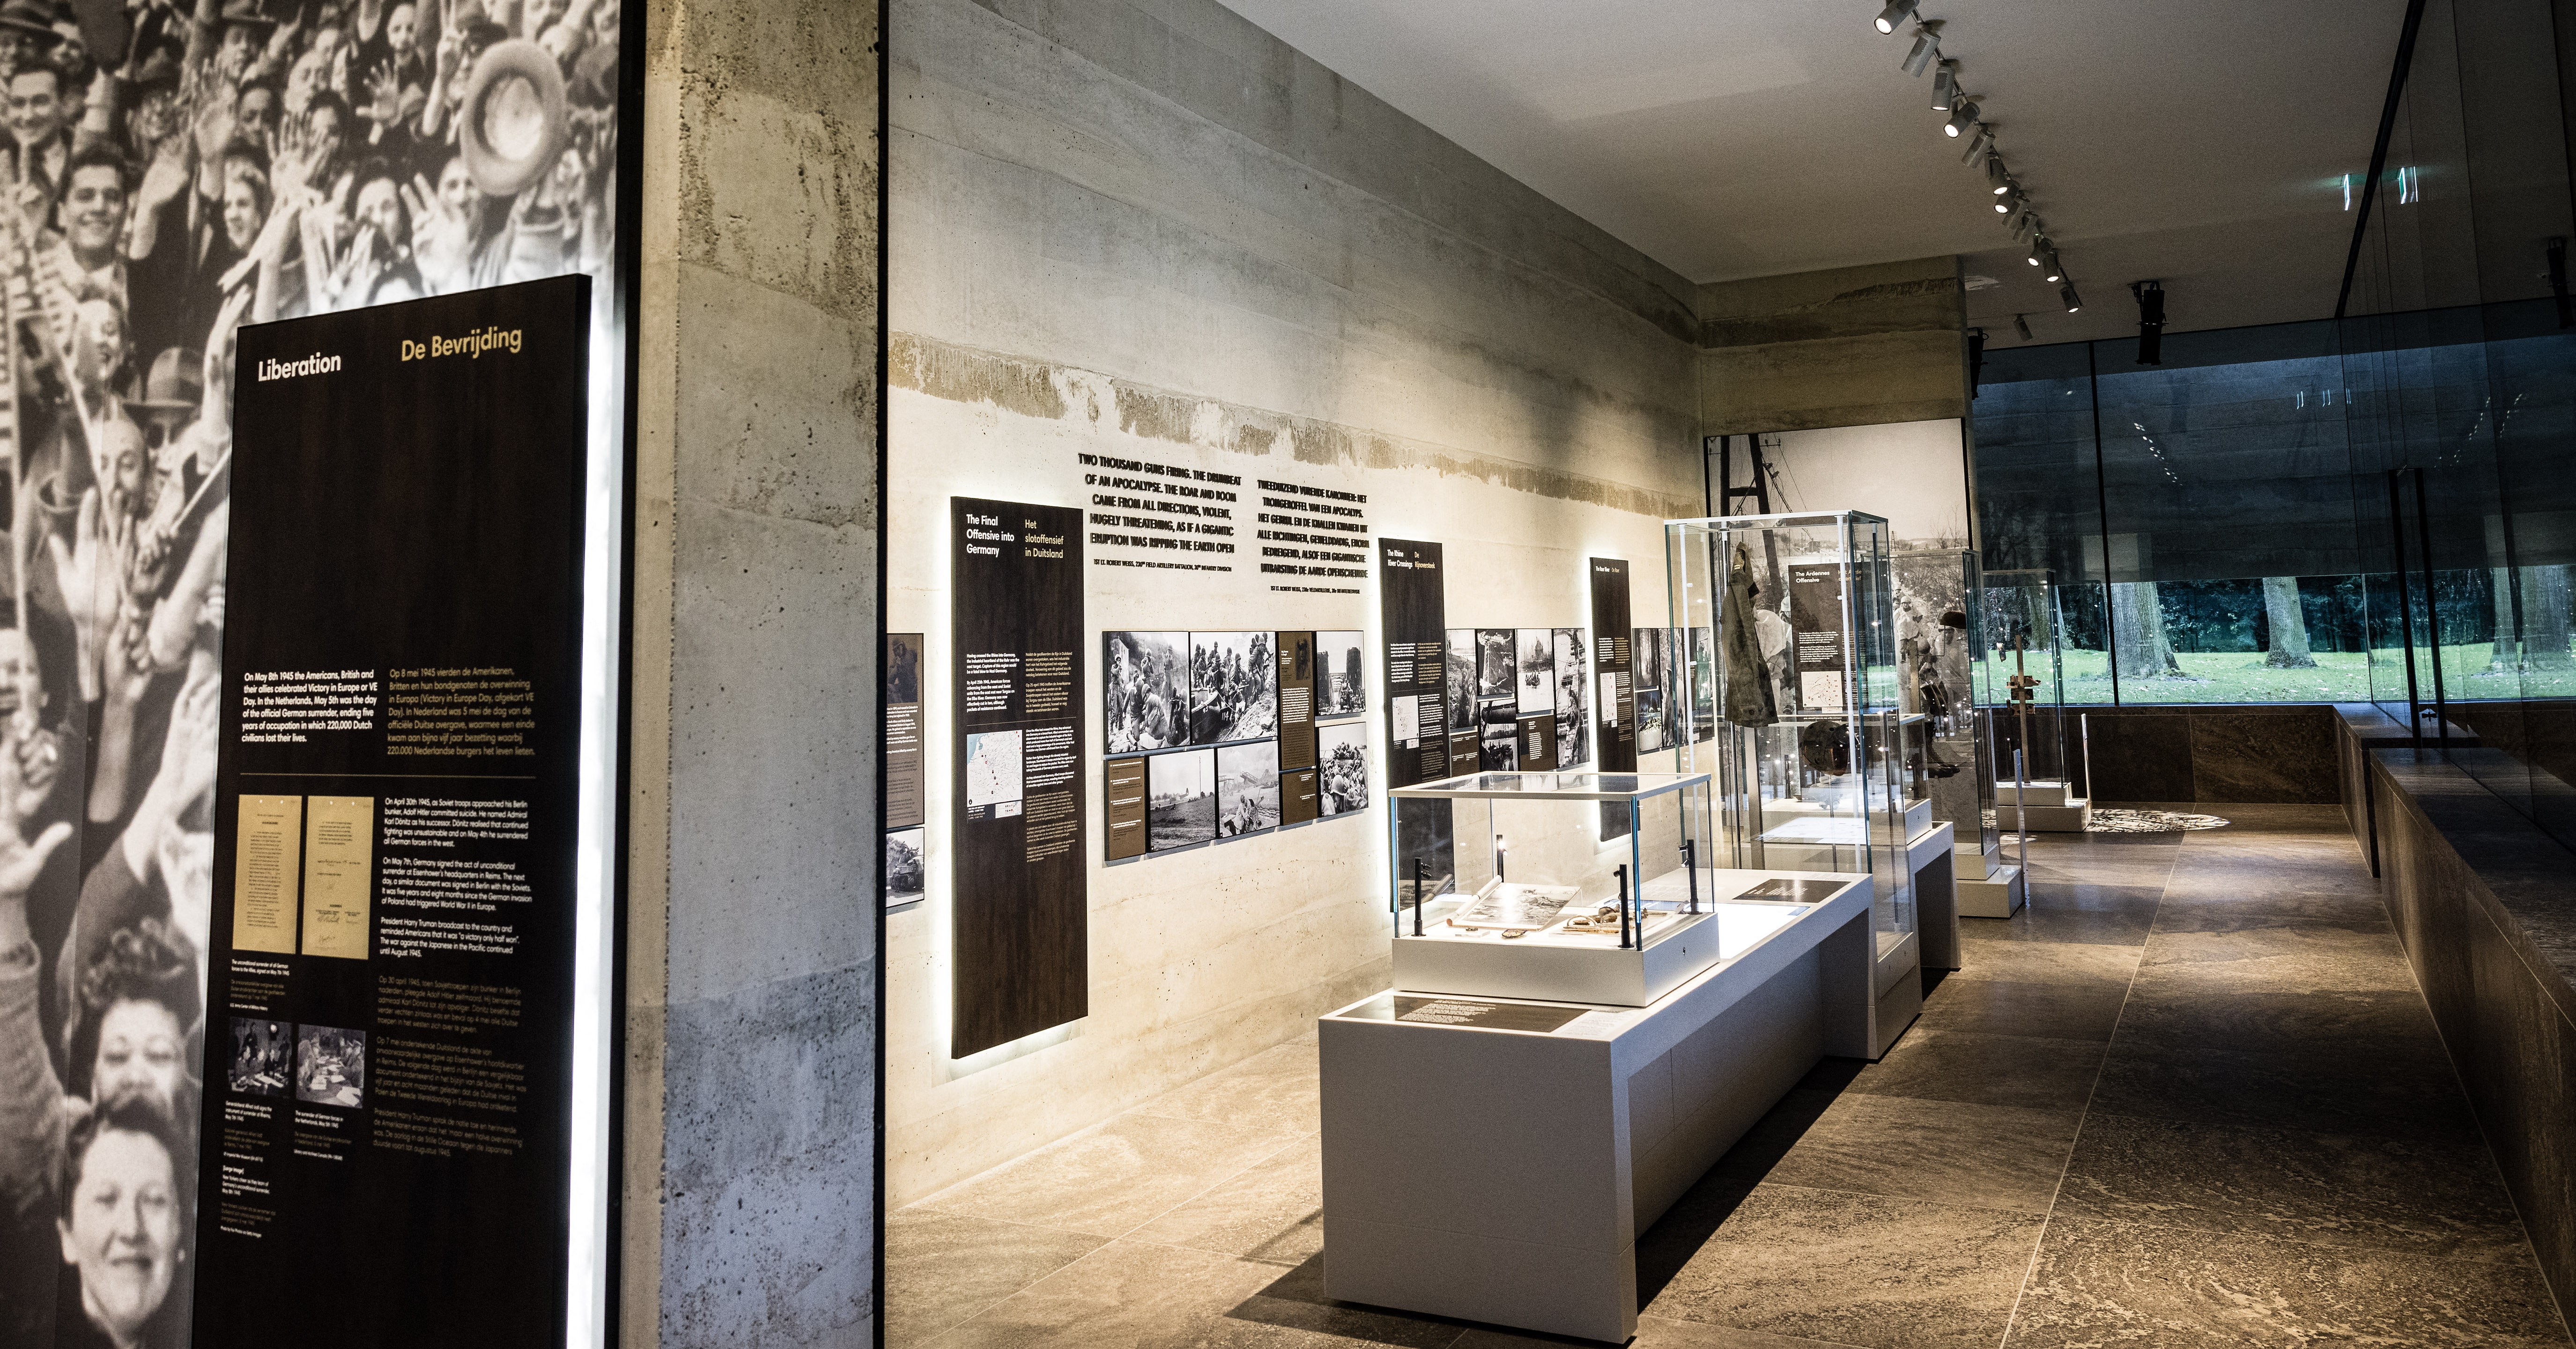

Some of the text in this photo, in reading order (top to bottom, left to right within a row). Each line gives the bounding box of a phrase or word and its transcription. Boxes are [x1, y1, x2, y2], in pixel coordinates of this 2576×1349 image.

[401, 326, 522, 361] De Bevrijding
[258, 353, 341, 381] Liberation
[1078, 453, 1241, 485] TWO THOUSAND GUNS FIRING. THE DRUMBEAT
[1085, 474, 1236, 501] OF AN APOCALYPSE. THE ROAR AND BOOM
[1257, 480, 1367, 503] TWEEDUIZEND VURENDE KANONNEN: HET
[1092, 494, 1231, 519] CAME FROM ALL DIRECTIONS, VIOLENT,
[1262, 497, 1363, 517] TROMGEROFFEL VAN EEN APOCALYPS.
[966, 514, 998, 525] The Final
[1025, 519, 1036, 529] Het
[1090, 514, 1234, 536] HUGELY THREATENING, AS IF A GIGANTIC
[1258, 513, 1270, 523] HET
[1294, 517, 1302, 526] EN
[1303, 518, 1311, 527] DE
[1311, 519, 1335, 529] KNALLEN
[1336, 522, 1359, 531] KWAMEN
[966, 529, 1014, 541] Offensive into
[1025, 533, 1063, 544] slotoffensief
[1257, 530, 1369, 547] ALLE RICHTINGEN, GEWELDDADIG, ENORM
[1090, 533, 1234, 553] ERUPTION WAS RIPPING THE EARTH OPEN
[966, 544, 999, 557] Germany
[1025, 547, 1063, 558] in Duitsland
[1262, 547, 1366, 562] BEDREIGEND, ALSOF EEN GIGANTISCHE
[1260, 563, 1368, 577] UITBARSTING DE AARDE OPENSCHEURDE
[1397, 560, 1413, 569] Crossings
[1414, 561, 1435, 569] Rijnoversteek
[244, 669, 374, 683] On May 8th 1945 the Americans, British and
[244, 685, 258, 693] their
[258, 684, 274, 693] allies
[274, 684, 307, 693] celebrated
[308, 684, 330, 693] Victory
[337, 683, 360, 693] Europe
[369, 682, 378, 691] VE
[243, 697, 256, 707] Day.
[264, 696, 274, 705] the
[275, 696, 313, 705] Netherlands,
[314, 696, 327, 706] May
[328, 695, 339, 704] 5th
[353, 695, 363, 704] the
[364, 695, 377, 706] day
[242, 707, 374, 718] of the official German surrender, ending five
[242, 720, 372, 731] years of occupation in which 220,000 Dutch
[241, 733, 307, 742] civilians lost their lives.
